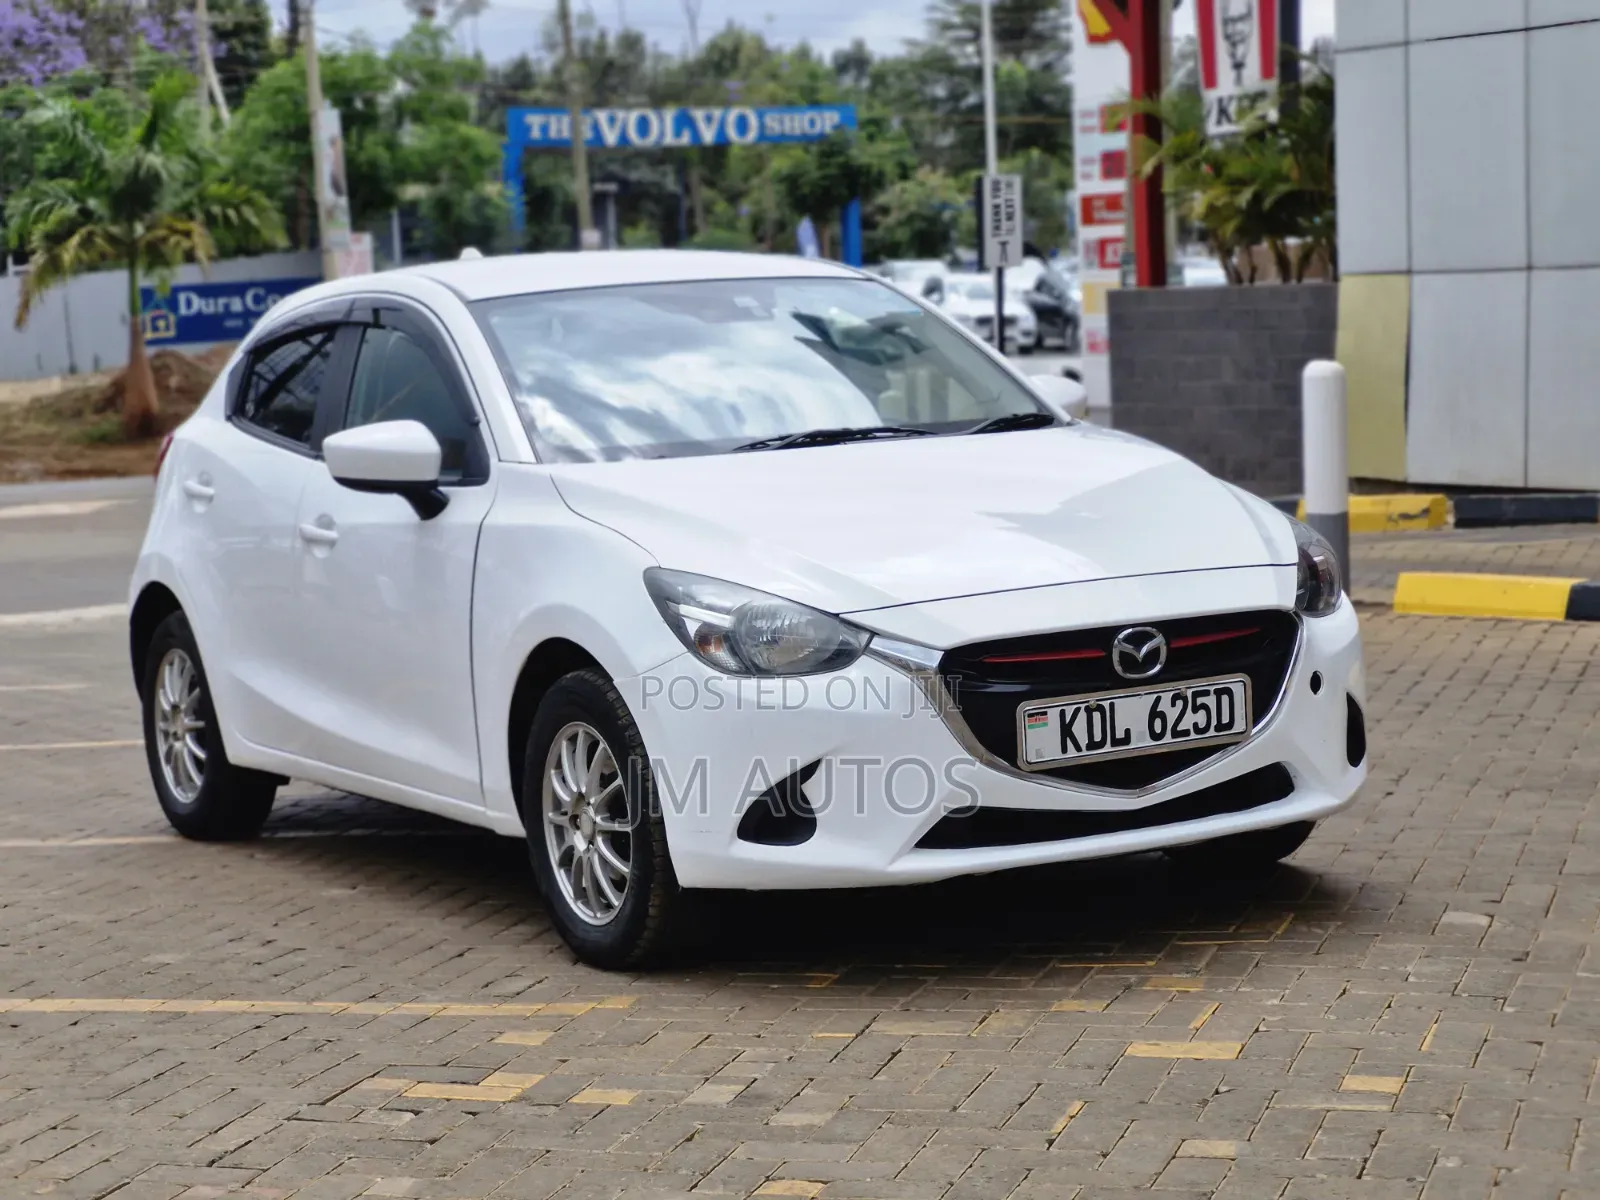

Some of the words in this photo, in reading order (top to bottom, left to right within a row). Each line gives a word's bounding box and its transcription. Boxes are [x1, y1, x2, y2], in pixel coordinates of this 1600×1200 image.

[595, 107, 759, 148] VOLVO
[764, 110, 840, 136] SHOP
[1059, 702, 1131, 754] KDL
[1148, 687, 1235, 741] 625D
